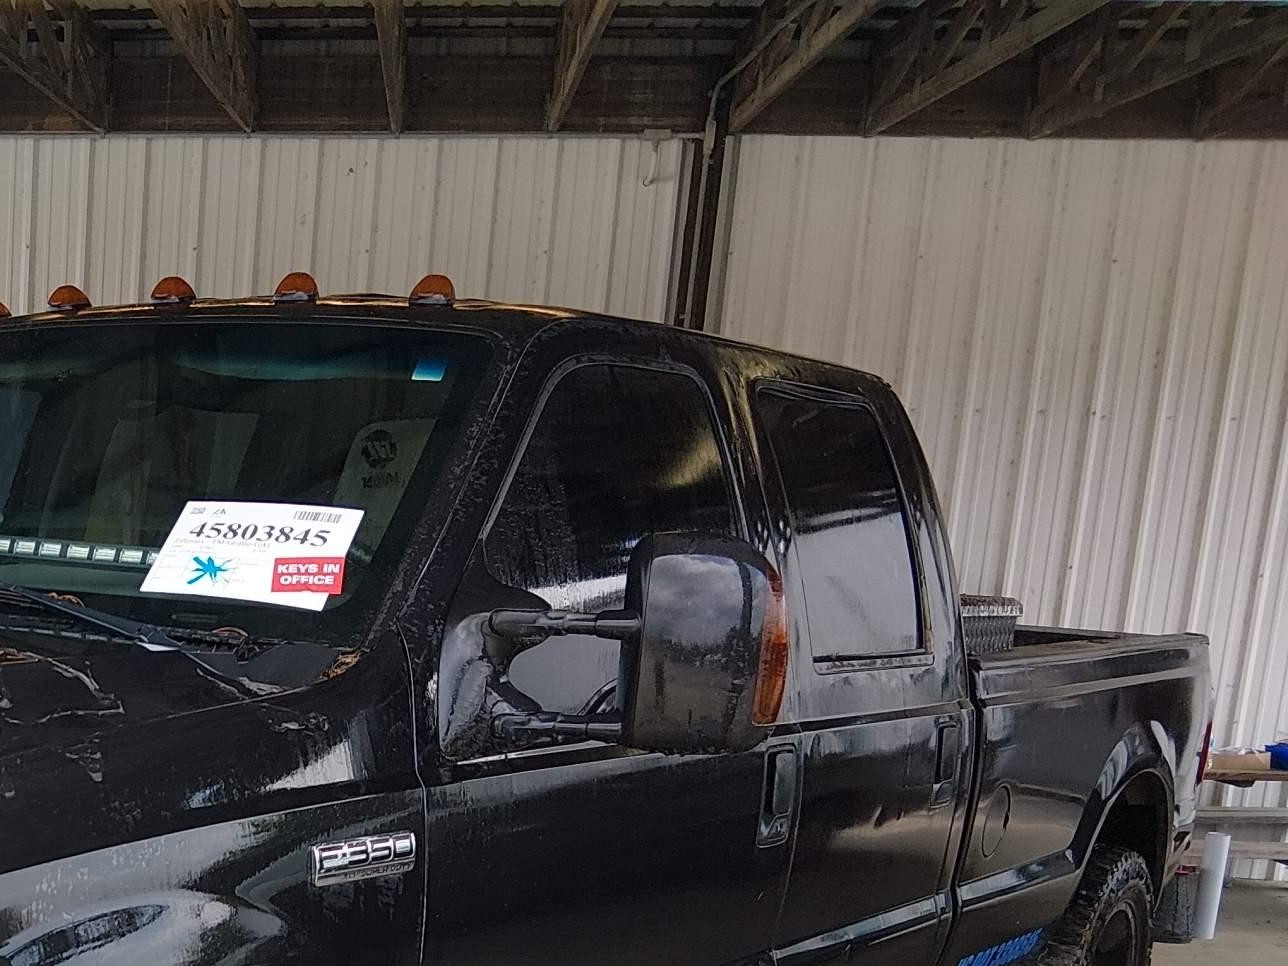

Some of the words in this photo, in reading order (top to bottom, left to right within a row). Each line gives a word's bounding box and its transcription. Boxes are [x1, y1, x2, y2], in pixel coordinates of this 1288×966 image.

[189, 520, 332, 548] 45803845
[277, 563, 319, 574] KEYS
[322, 563, 341, 574] IN
[279, 575, 335, 585] OFFICE
